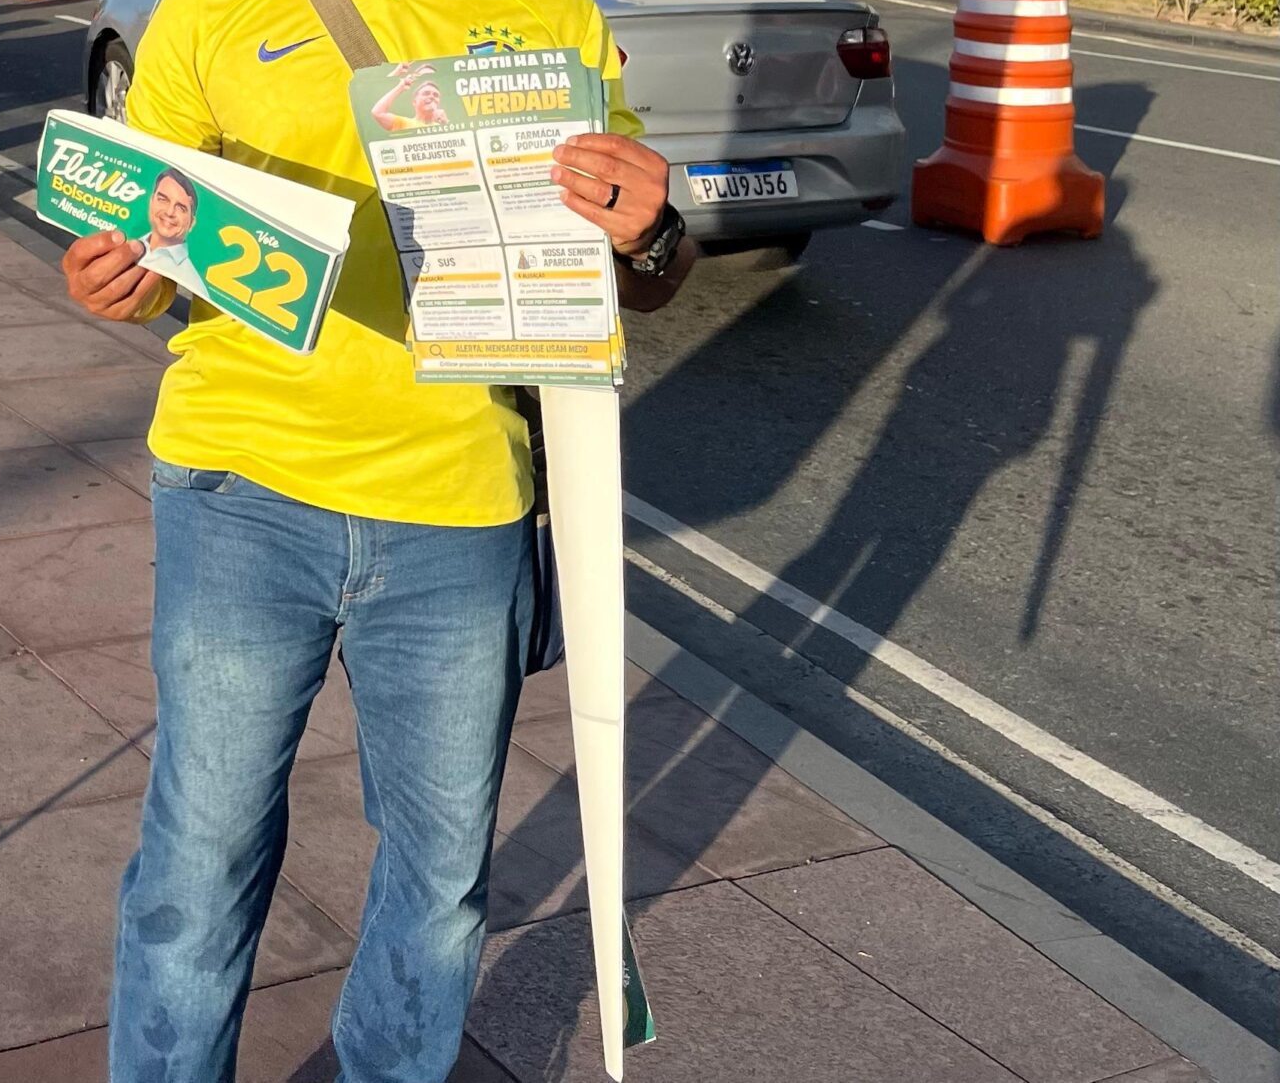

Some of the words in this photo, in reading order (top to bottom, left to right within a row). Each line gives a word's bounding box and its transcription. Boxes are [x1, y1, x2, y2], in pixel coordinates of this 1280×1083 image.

[456, 73, 543, 96] CARTILHA
[545, 71, 572, 90] DA
[462, 88, 572, 117] VERDADE
[416, 122, 466, 134] ALEGAÇÕES
[478, 115, 539, 127] DOCUMENTOS
[515, 128, 562, 141] FARMÁCIA
[402, 138, 466, 153] APOSENTADORIA
[516, 138, 557, 152] POPULAR
[404, 154, 410, 163] E
[412, 149, 457, 162] REAJUSTES
[46, 138, 147, 203] Flávio
[701, 173, 787, 199] PLU9J56
[51, 174, 131, 220] Bolsonaro
[57, 197, 89, 223] Alfredo
[86, 210, 118, 232] Gaspar
[255, 229, 280, 249] Vote
[542, 248, 566, 257] NOSSA
[568, 247, 600, 256] SENHORA
[437, 257, 456, 267] SUS
[543, 257, 584, 267] APARECIDA
[205, 224, 308, 332] 22
[456, 344, 483, 353] ALERTA:
[485, 344, 529, 353] MENSAGENS
[531, 344, 544, 353] QUE
[546, 344, 567, 353] USAM
[568, 344, 588, 354] MEDO
